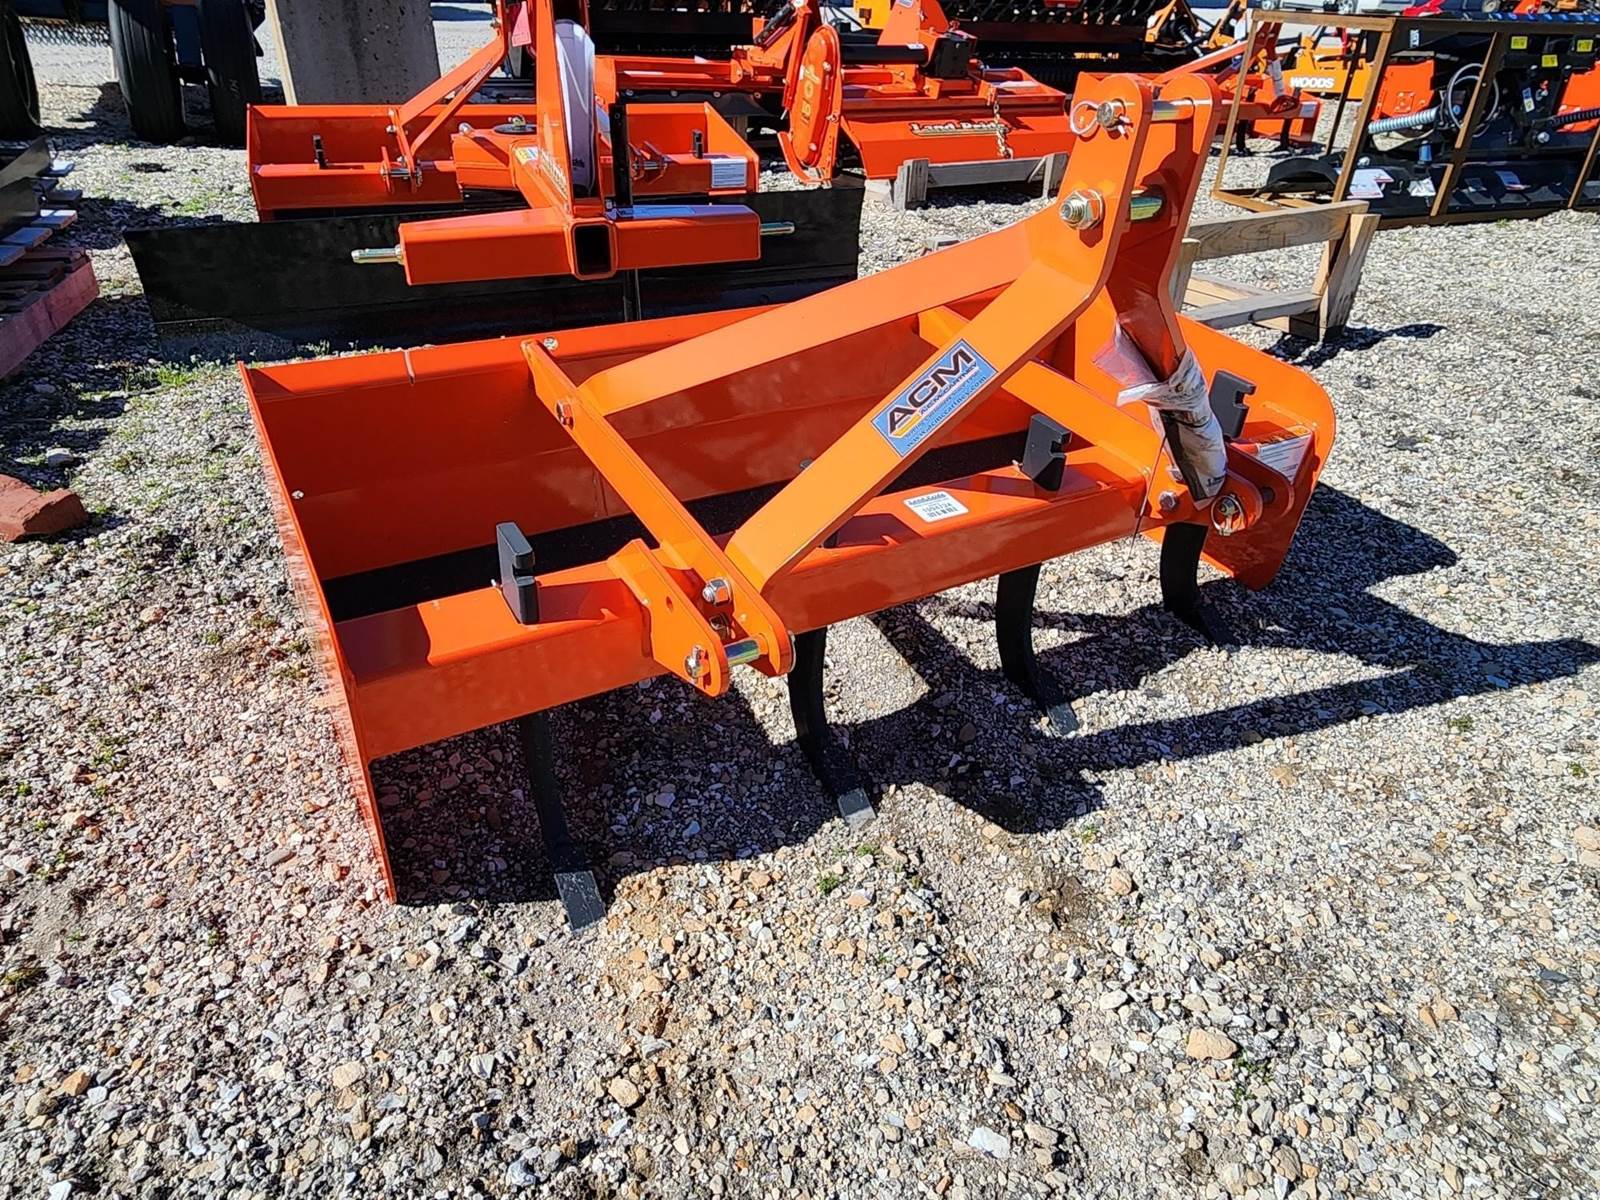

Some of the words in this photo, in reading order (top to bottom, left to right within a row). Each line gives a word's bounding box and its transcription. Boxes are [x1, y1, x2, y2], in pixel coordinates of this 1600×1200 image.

[1290, 77, 1335, 88] WOODS
[910, 122, 956, 135] Land
[888, 347, 976, 435] ACM
